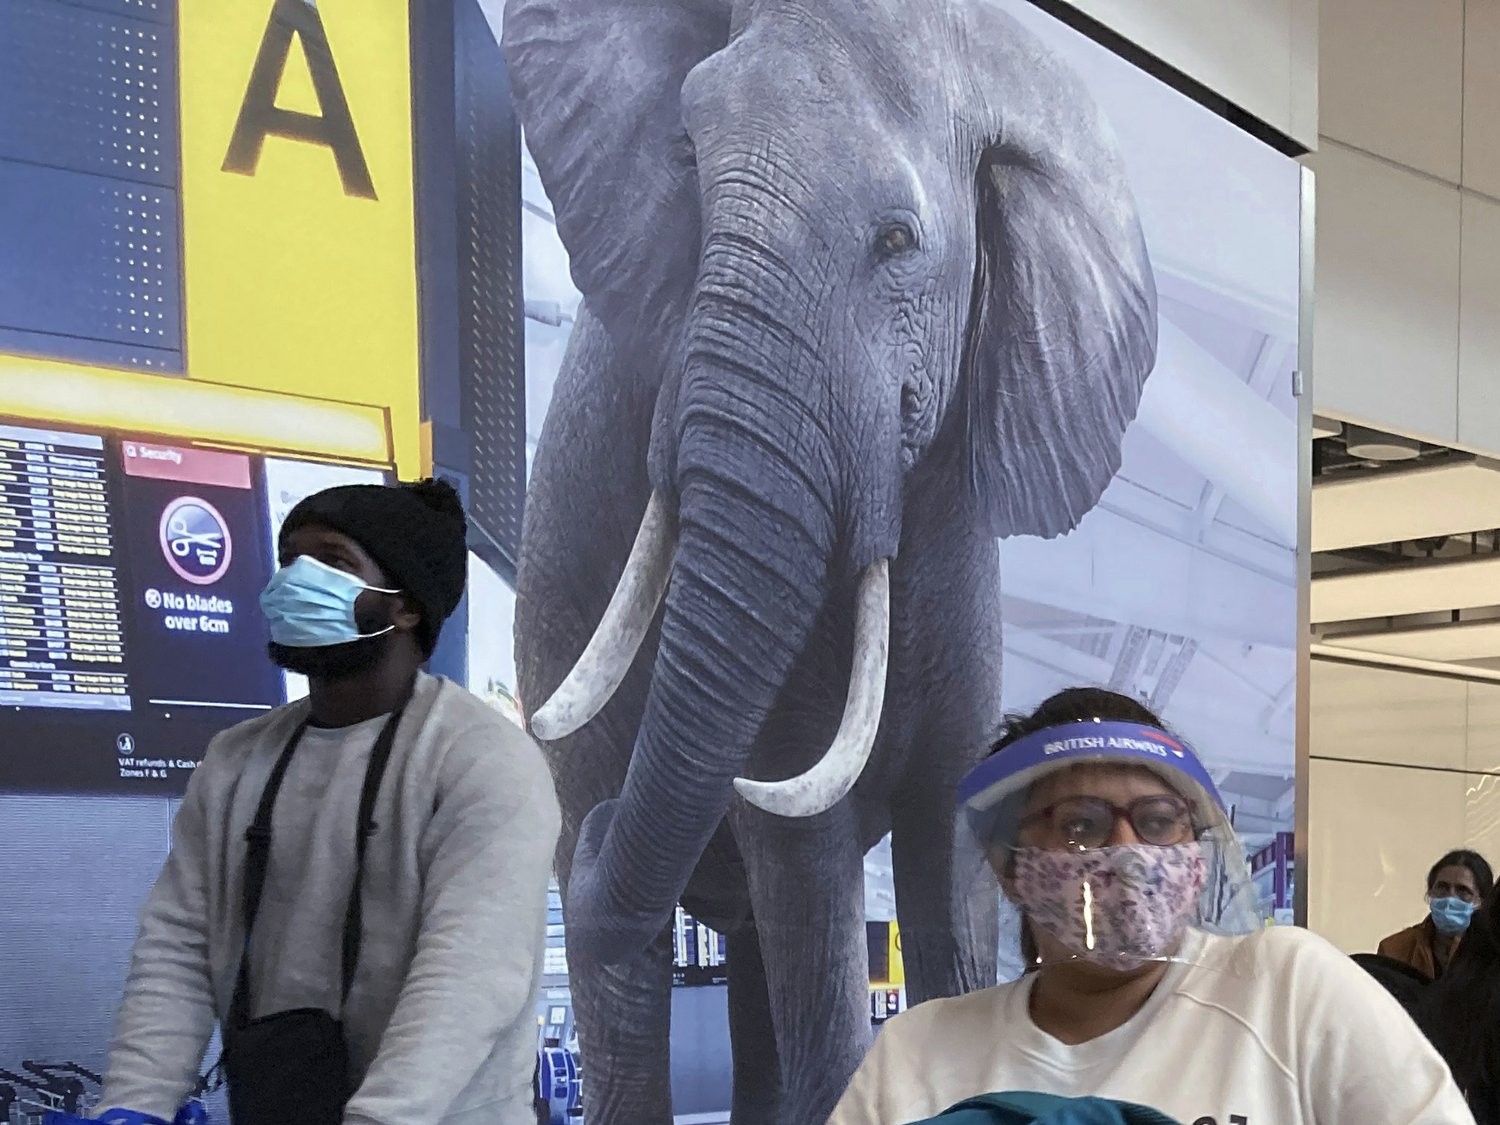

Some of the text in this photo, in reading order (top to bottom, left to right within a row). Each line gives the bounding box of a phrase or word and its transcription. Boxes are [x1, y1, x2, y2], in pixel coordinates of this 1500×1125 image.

[221, 0, 379, 201] A
[163, 592, 233, 614] No blades
[165, 615, 229, 633] over 6cm
[1043, 736, 1167, 757] BRITISH AIRWAYS
[118, 758, 134, 767] VAT
[176, 759, 196, 768] Cash
[120, 768, 144, 777] Zones
